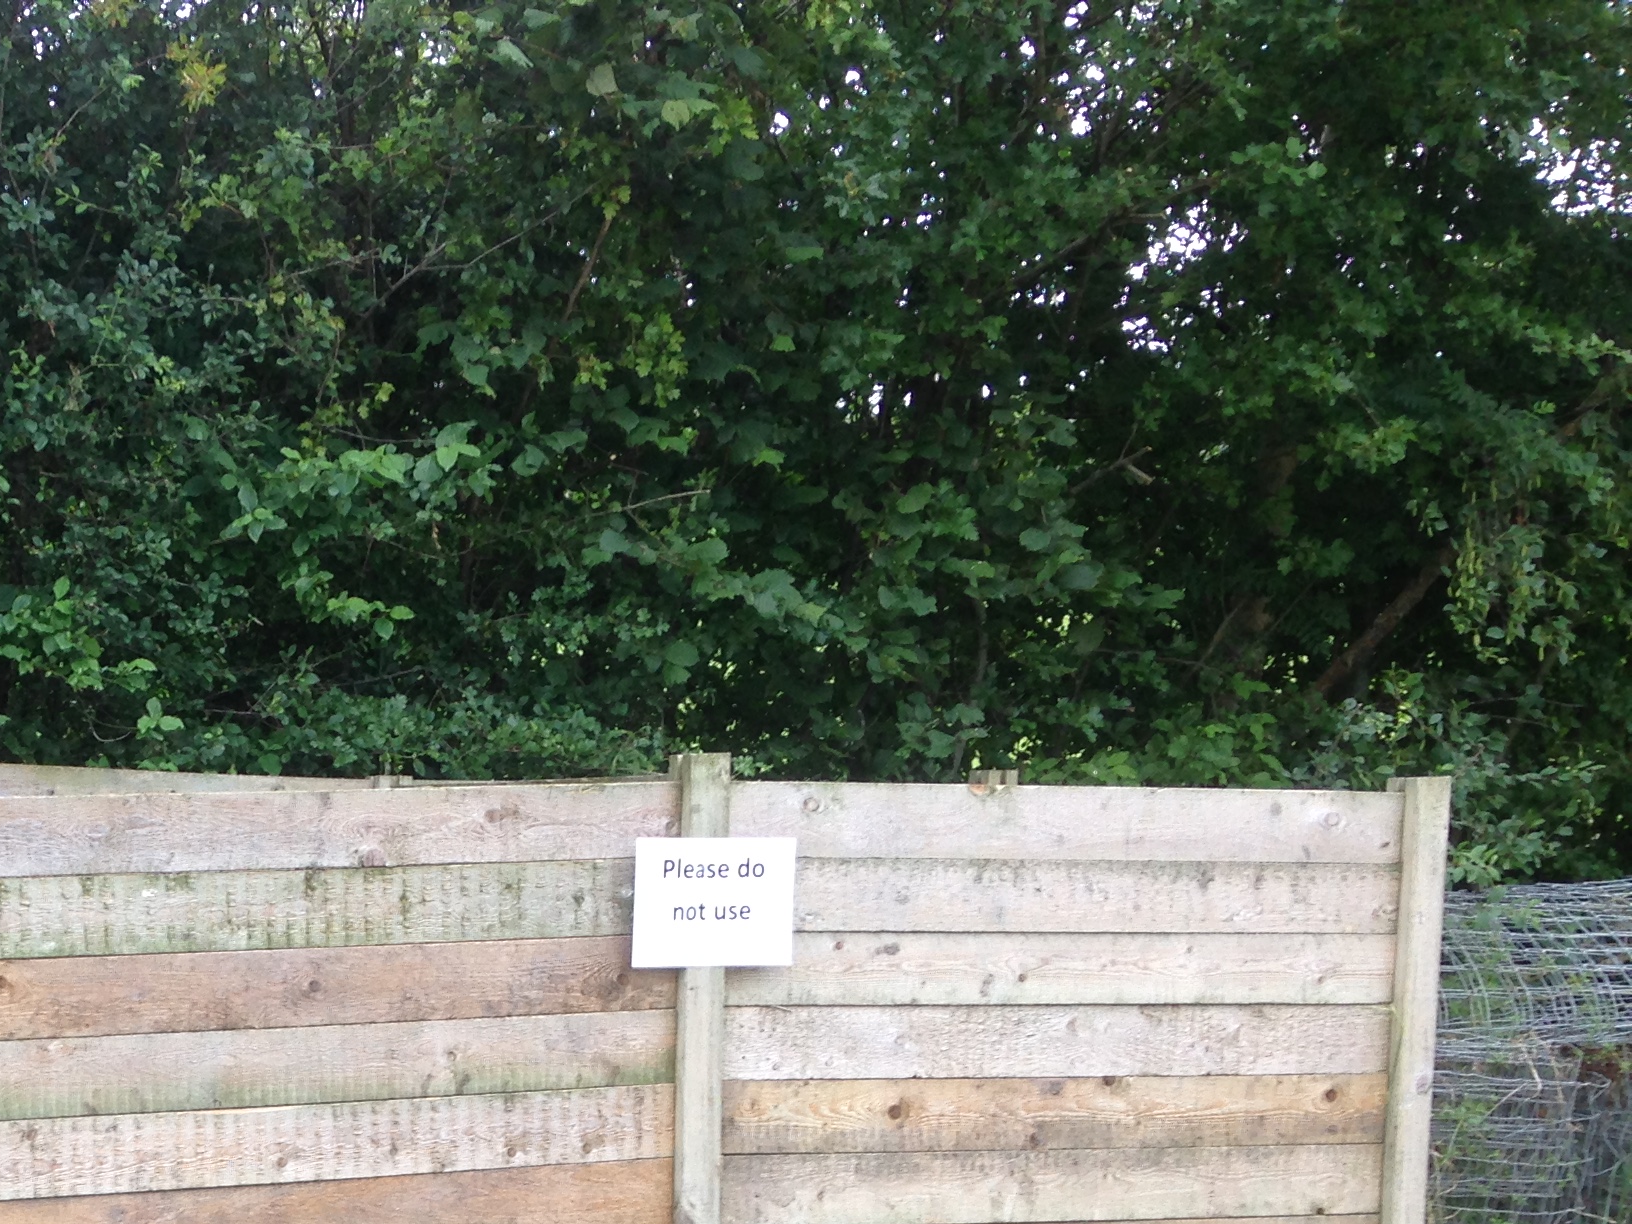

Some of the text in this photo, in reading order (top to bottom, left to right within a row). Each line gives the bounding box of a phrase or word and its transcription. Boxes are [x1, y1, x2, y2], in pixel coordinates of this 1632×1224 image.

[663, 858, 765, 879] Please do
[673, 903, 751, 921] not use
